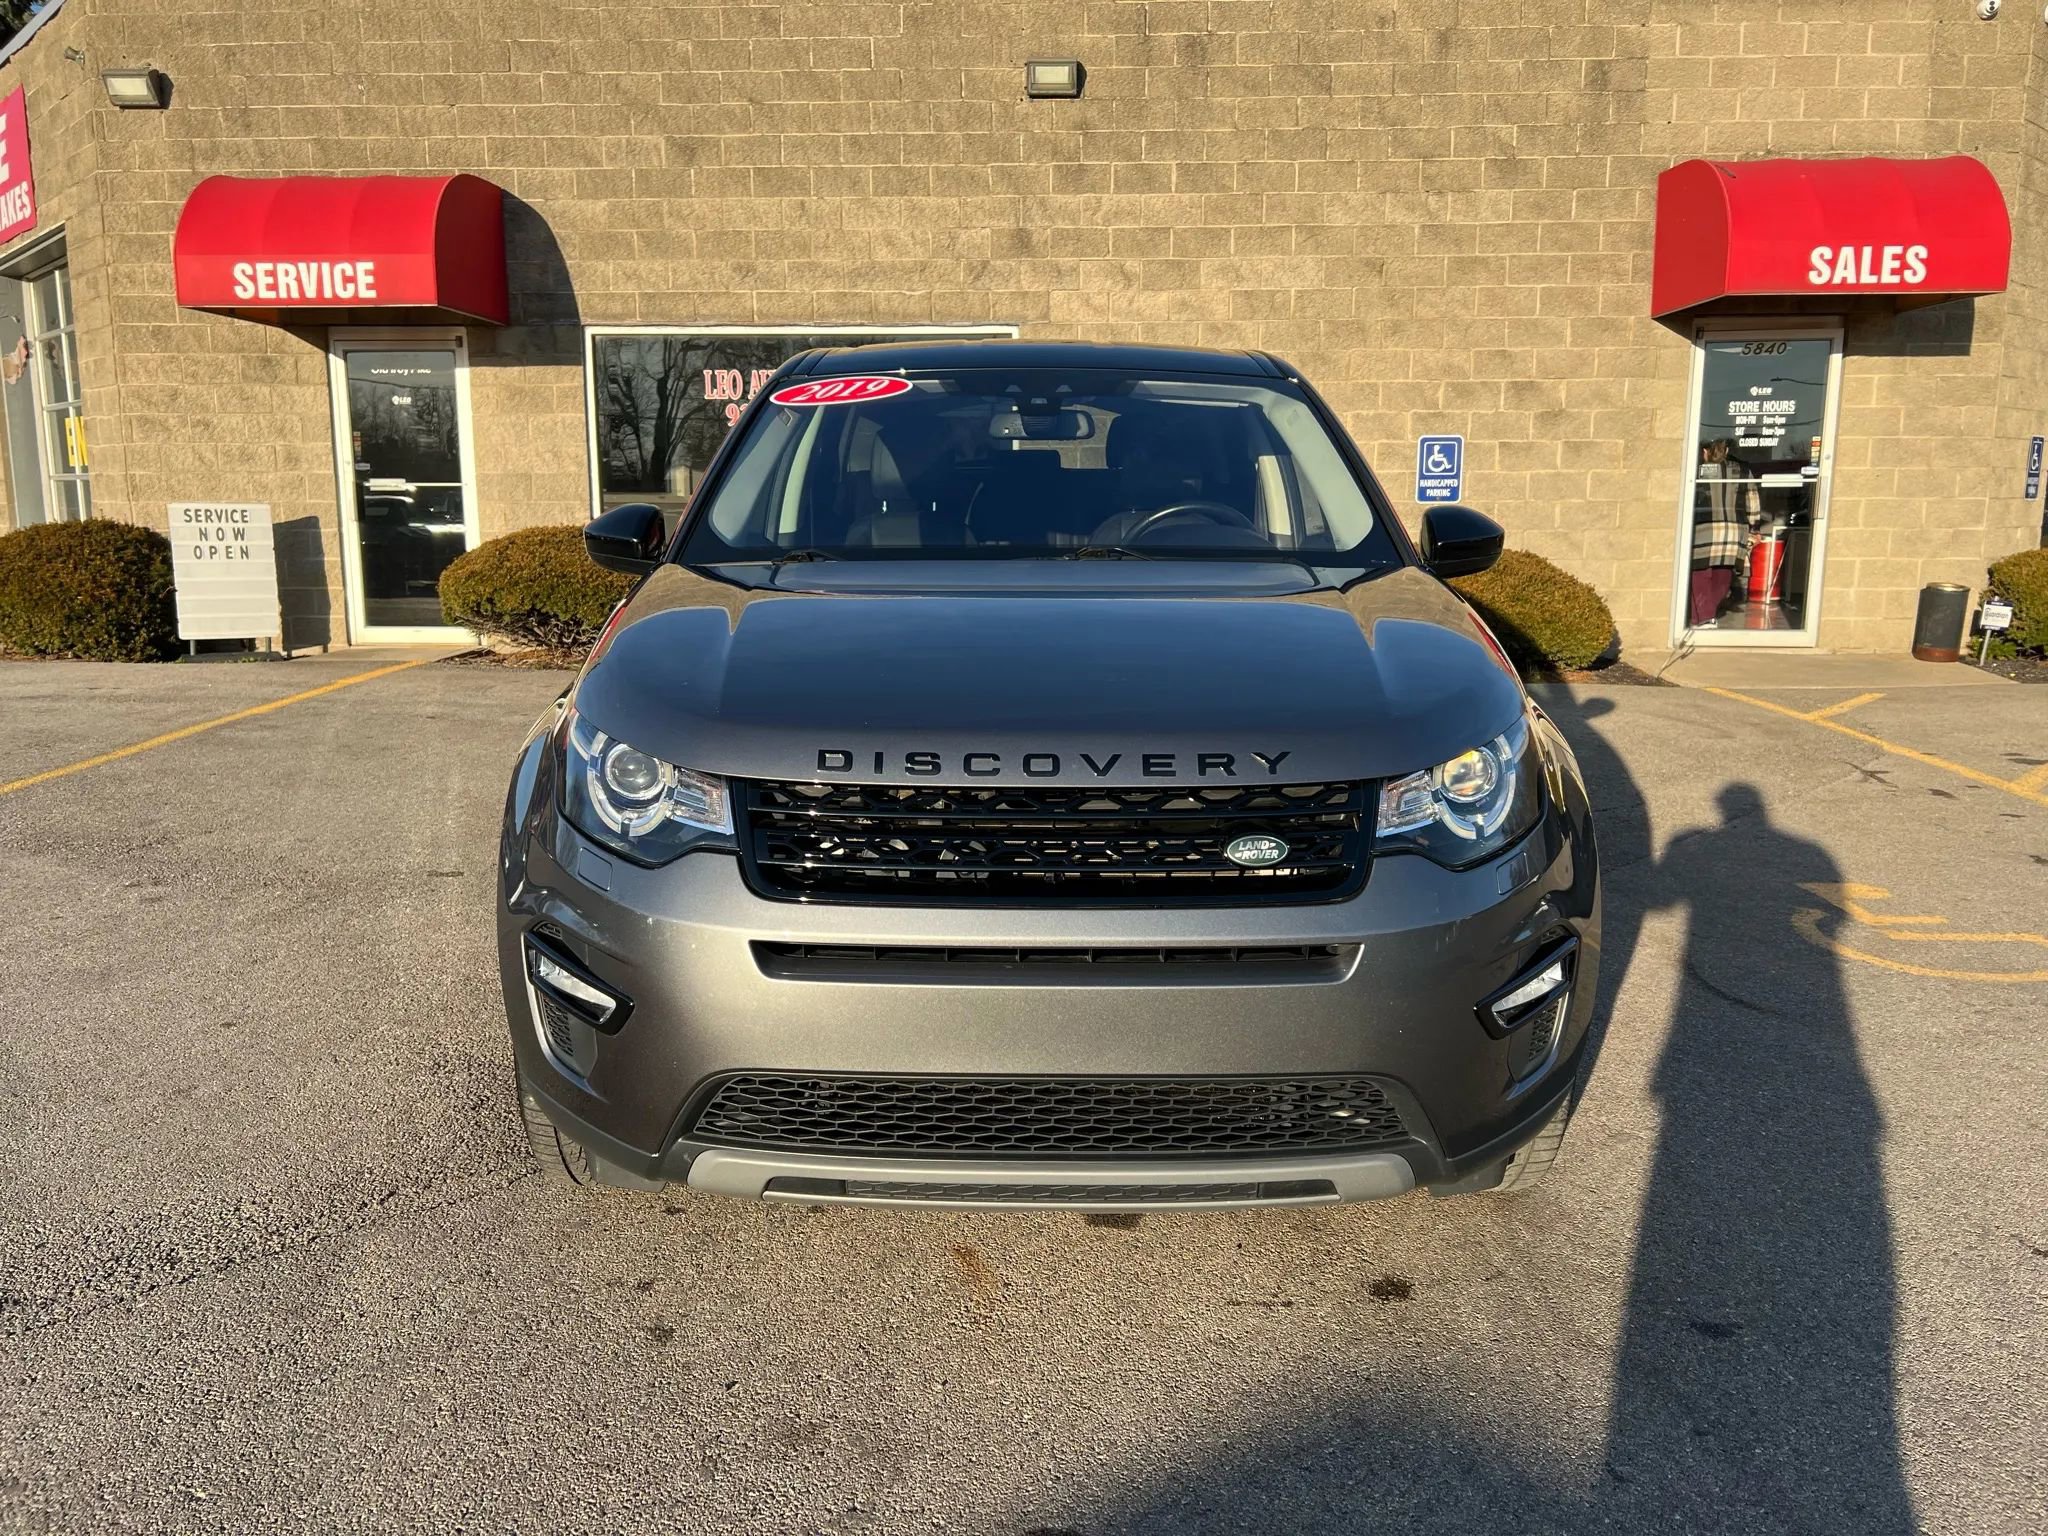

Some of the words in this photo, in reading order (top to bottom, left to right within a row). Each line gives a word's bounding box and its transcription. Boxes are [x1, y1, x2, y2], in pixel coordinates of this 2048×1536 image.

[0, 181, 31, 231] AKES
[1808, 245, 1928, 285] SALES
[233, 262, 377, 300] SERVICE
[1741, 342, 1787, 355] 5840
[703, 369, 743, 400] LEO
[788, 379, 891, 402] 2019
[1729, 400, 1760, 413] STORE
[1763, 400, 1796, 412] HOURS
[725, 403, 749, 427] 9
[1735, 427, 1745, 436] SAT
[1739, 438, 1758, 447] CLOSED
[1759, 438, 1779, 447] SUNDAY
[1420, 479, 1458, 488] HANDICAPPED
[1426, 489, 1451, 497] PARKING
[183, 508, 249, 523] SERVICE
[198, 526, 246, 541] NOW
[193, 545, 250, 560] OPEN
[816, 748, 1292, 778] DISCOVERY
[1238, 840, 1270, 851] LAND
[1241, 849, 1279, 860] ROVER
